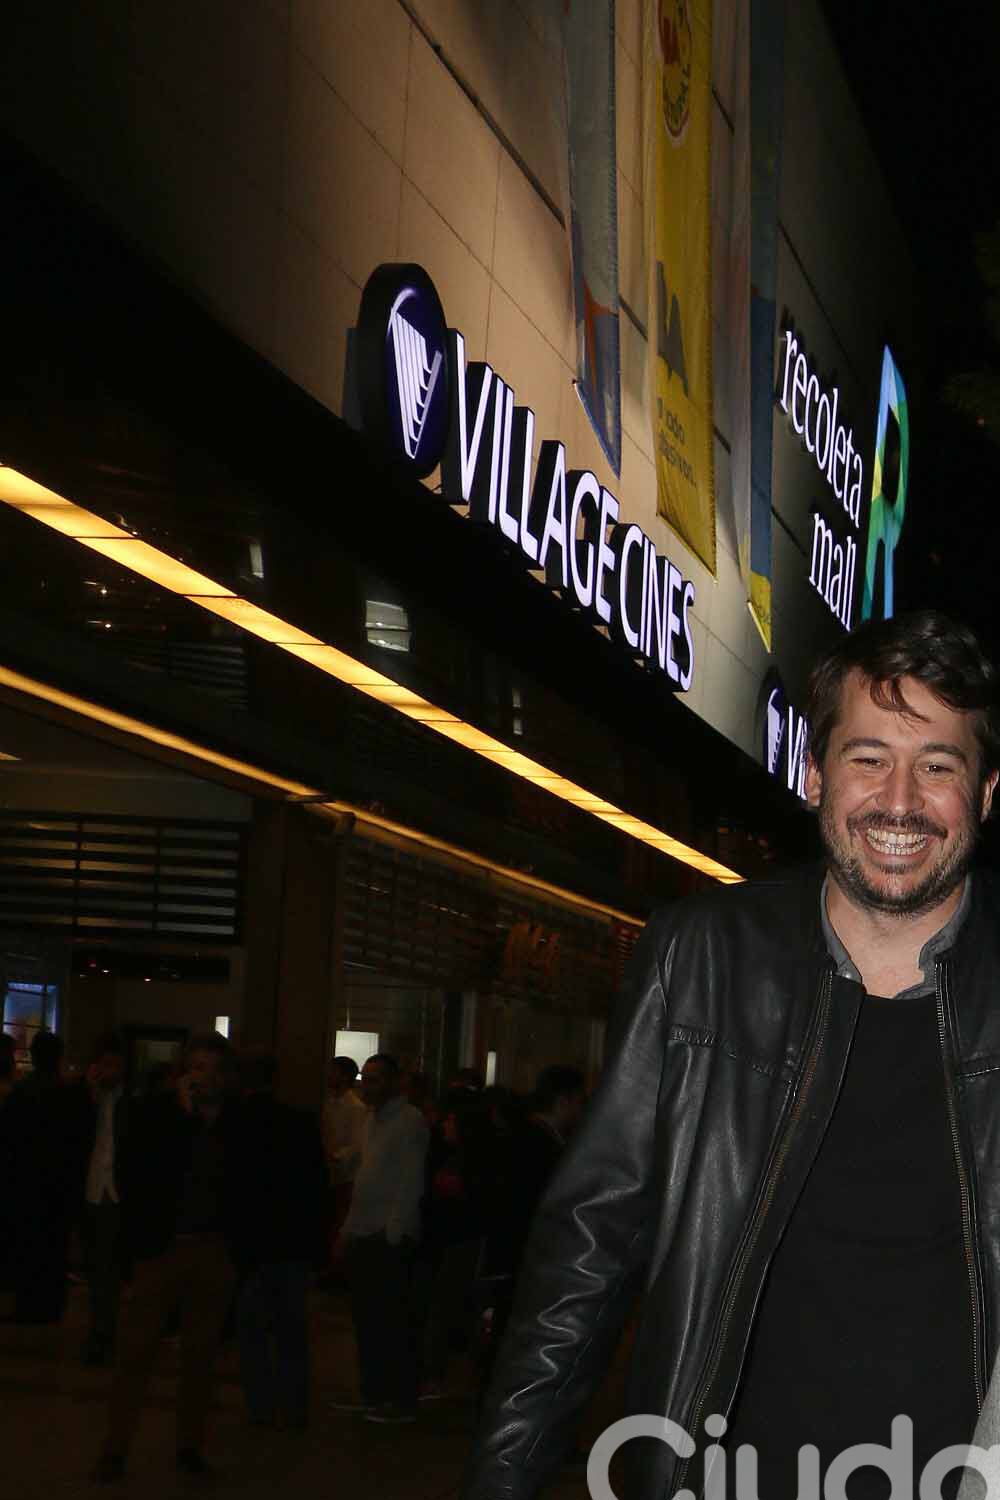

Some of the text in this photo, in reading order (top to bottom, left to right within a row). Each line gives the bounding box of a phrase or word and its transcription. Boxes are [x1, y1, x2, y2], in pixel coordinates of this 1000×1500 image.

[456, 331, 695, 692] VILLAGE CINES
[779, 329, 864, 529] recoleta
[808, 511, 857, 633] mall
